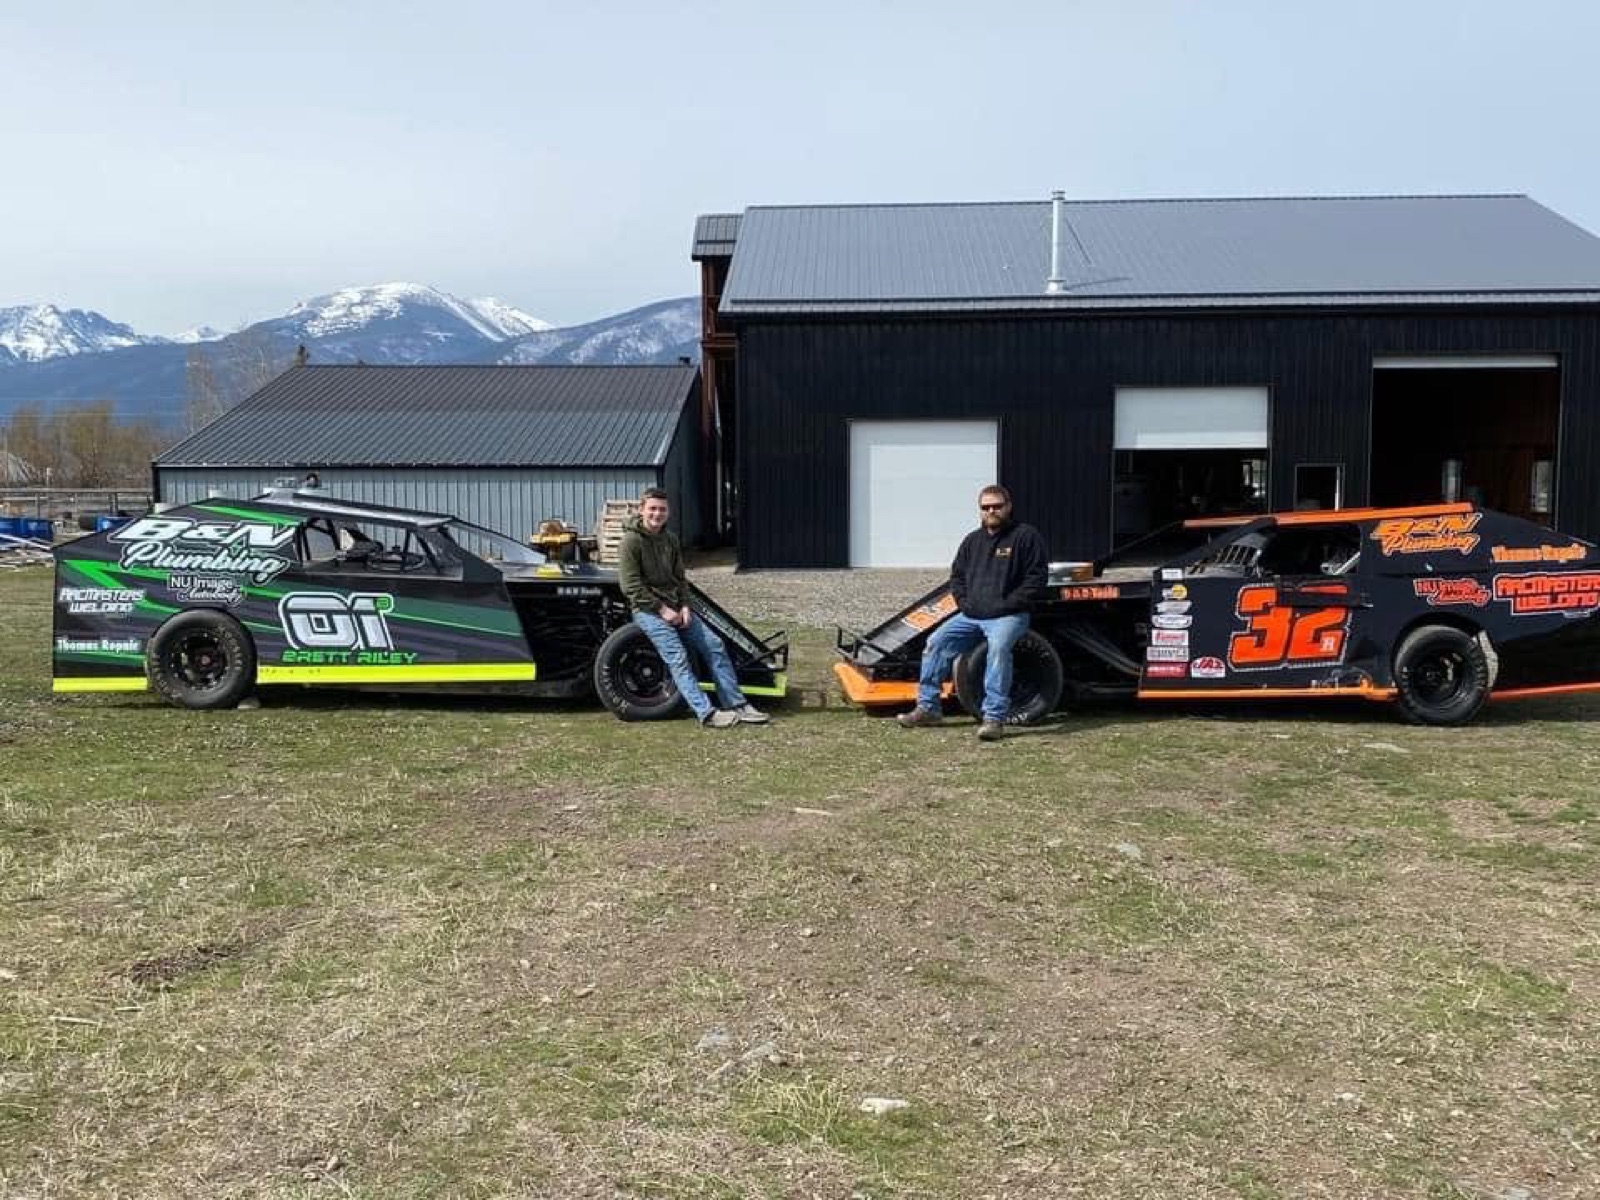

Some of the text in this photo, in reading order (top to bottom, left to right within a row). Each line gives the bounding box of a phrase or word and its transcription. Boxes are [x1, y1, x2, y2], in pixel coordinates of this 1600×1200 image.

[112, 516, 298, 549] B&N
[121, 541, 288, 584] Plumbing
[171, 576, 233, 591] NU Image
[279, 591, 394, 651] 01
[1227, 583, 1352, 672] 32
[282, 651, 418, 664] BRETT RILEY
